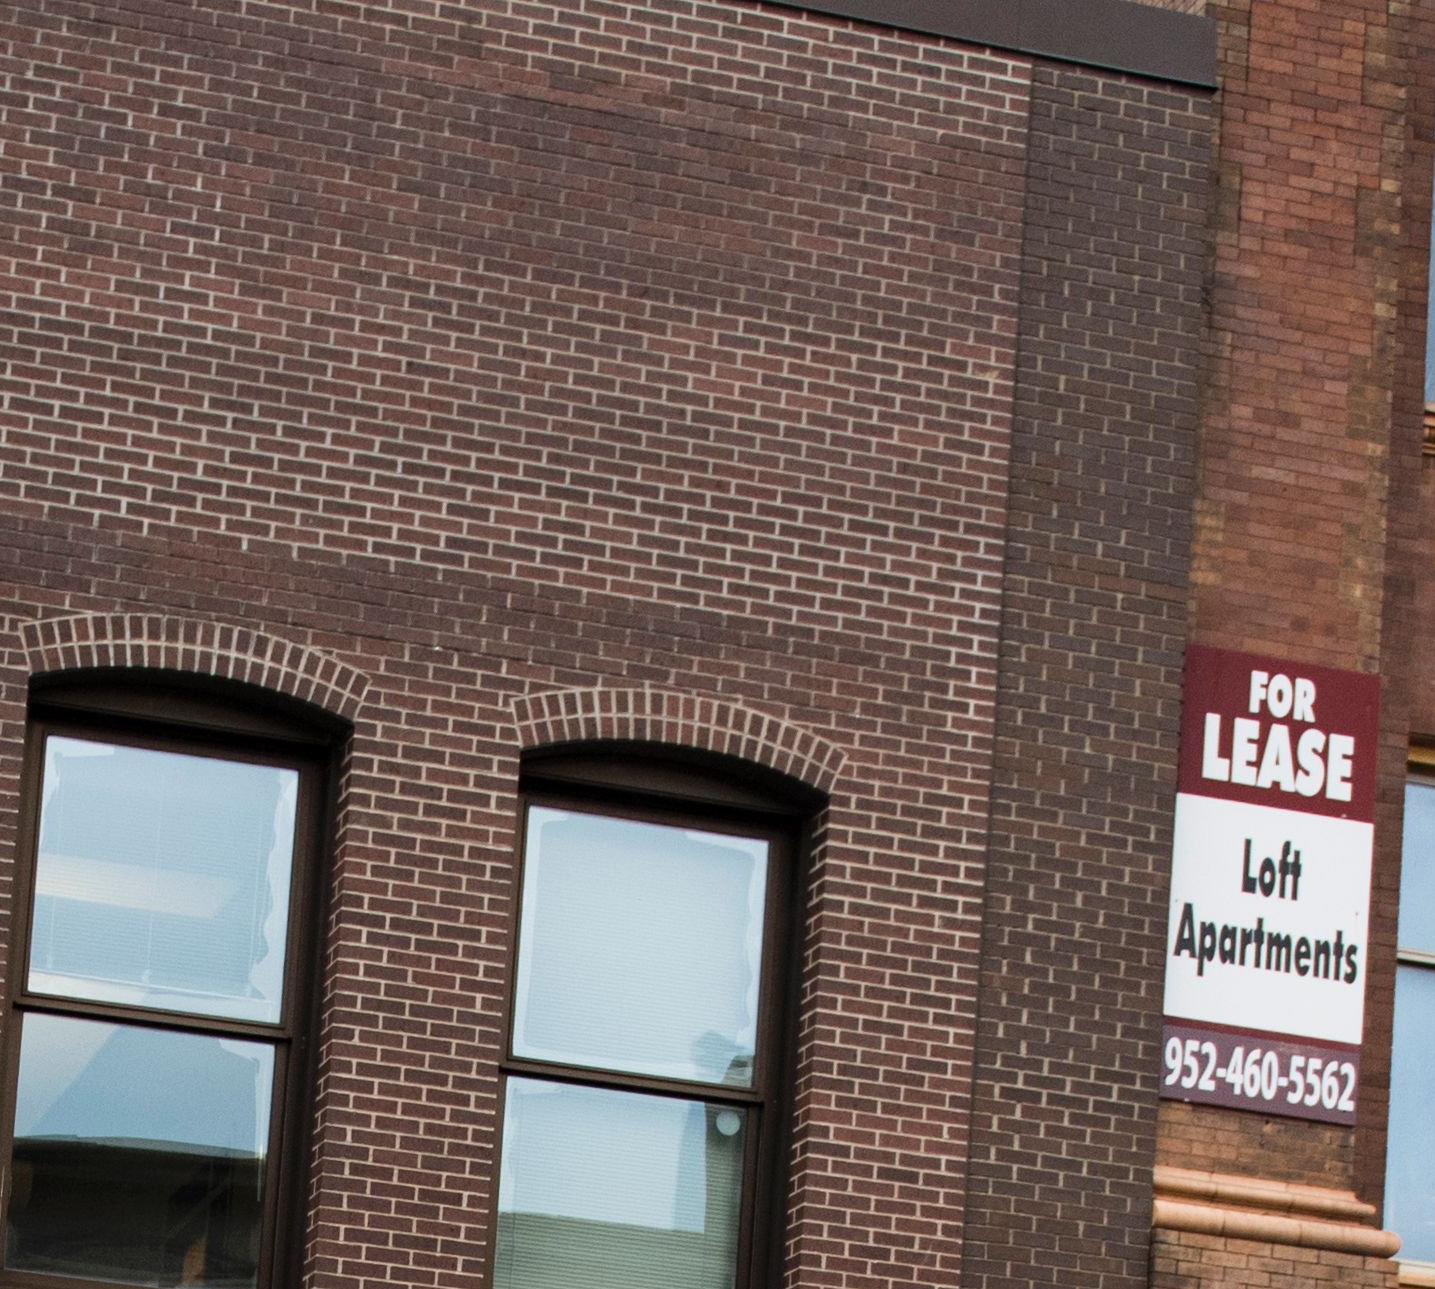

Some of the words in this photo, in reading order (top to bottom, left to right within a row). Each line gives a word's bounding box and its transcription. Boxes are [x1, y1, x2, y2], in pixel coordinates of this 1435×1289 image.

[1248, 669, 1316, 723] FOR
[1200, 712, 1355, 802] LEASE
[1240, 838, 1303, 901] Loft
[1173, 902, 1359, 985] Apartments
[1163, 1035, 1356, 1113] 952-460-5562
